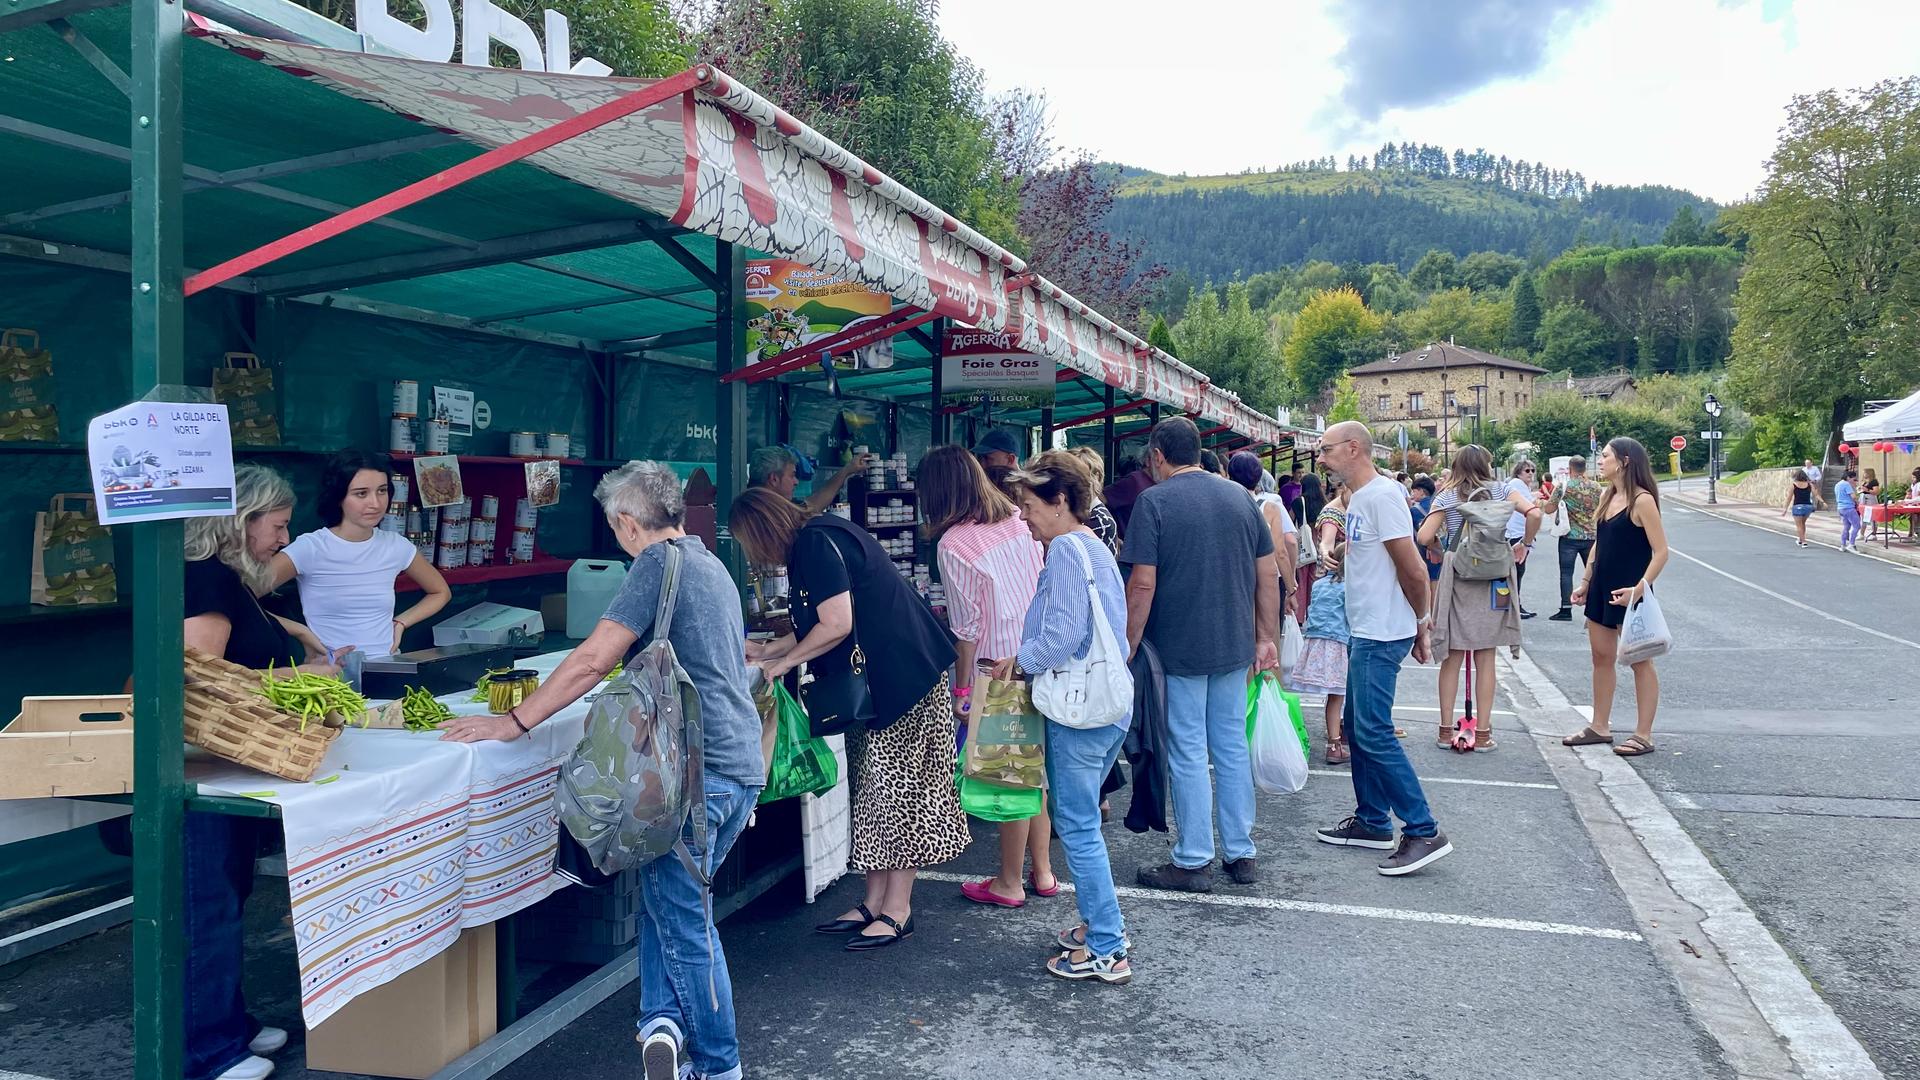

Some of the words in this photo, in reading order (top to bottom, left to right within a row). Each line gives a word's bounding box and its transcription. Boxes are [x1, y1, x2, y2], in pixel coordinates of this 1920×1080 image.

[951, 333, 1011, 351] AGERRIA
[962, 359, 995, 368] Foie
[1000, 358, 1040, 368] Gras
[1006, 369, 1039, 377] Basques
[171, 412, 181, 421] LA
[183, 412, 206, 421] GILDA
[207, 413, 221, 422] DEL
[174, 425, 200, 435] NORTE
[686, 423, 711, 440] bbk
